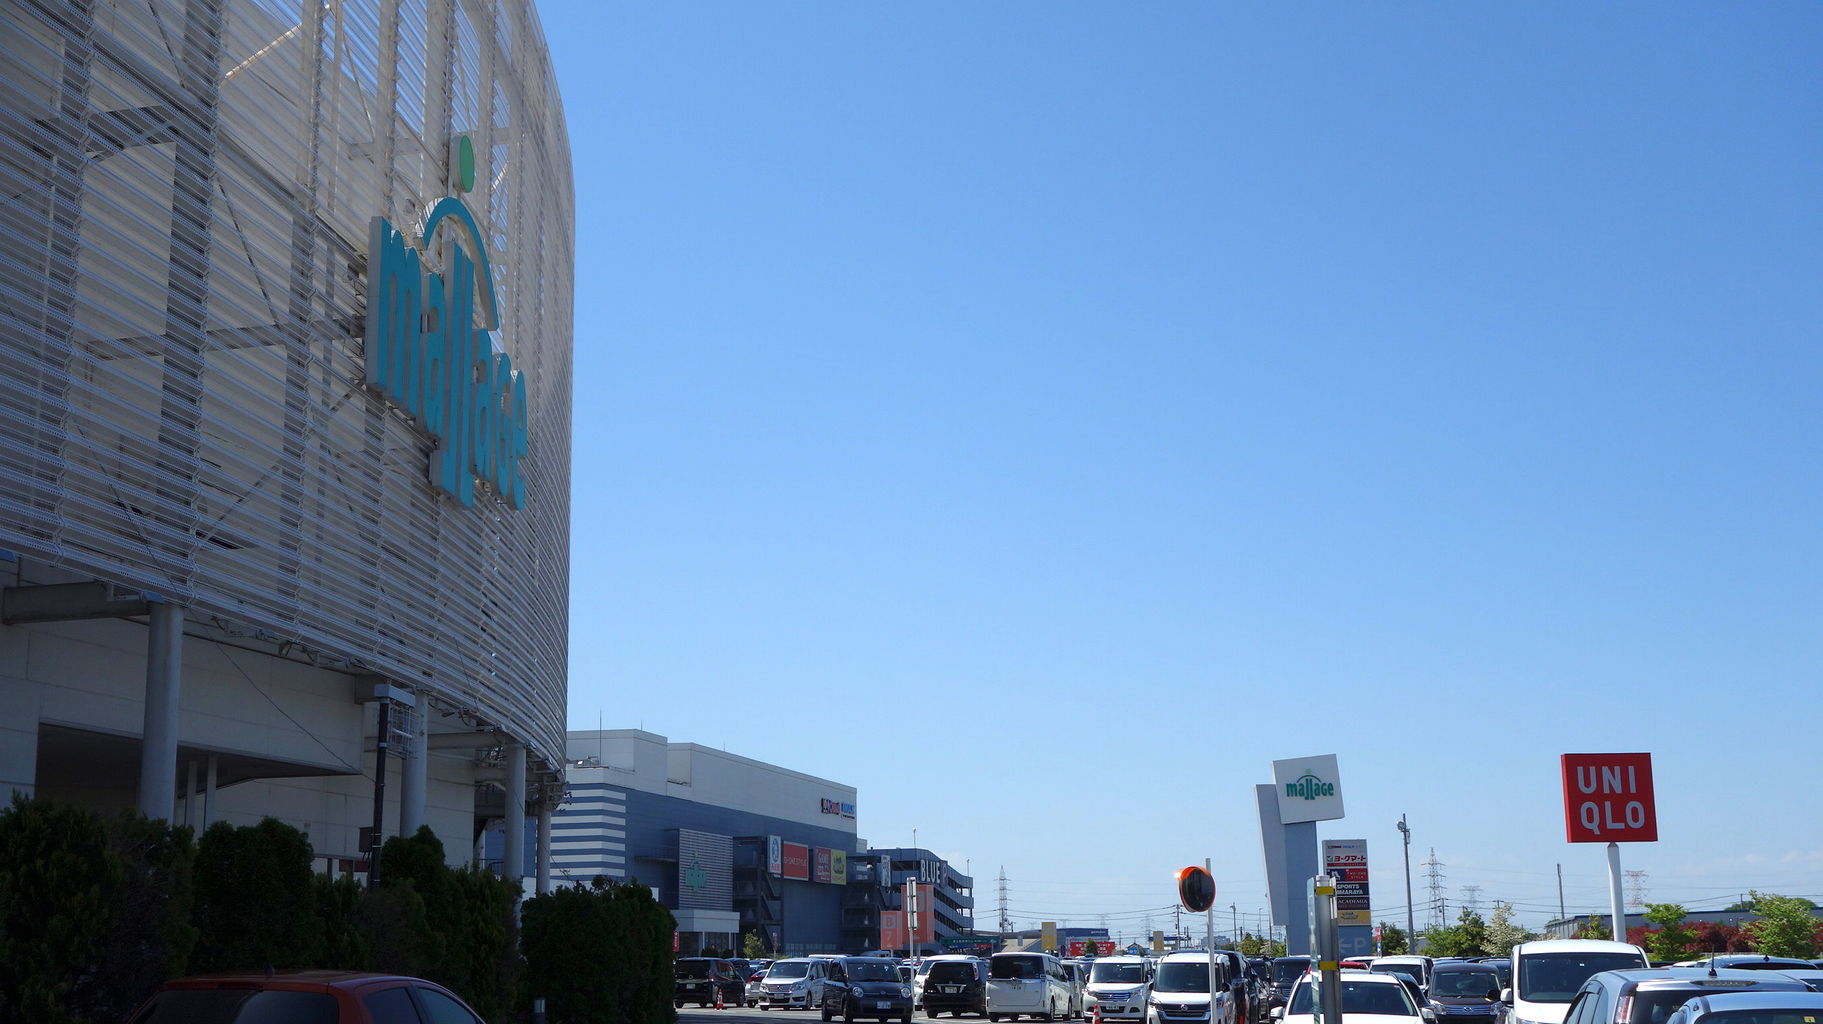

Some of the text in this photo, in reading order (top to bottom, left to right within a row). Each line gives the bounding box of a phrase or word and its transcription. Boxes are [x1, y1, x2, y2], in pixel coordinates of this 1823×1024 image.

[1577, 765, 1637, 794] UNI
[1580, 800, 1645, 835] QLO
[920, 859, 941, 884] BLUE
[1334, 855, 1366, 863] ヨークマート
